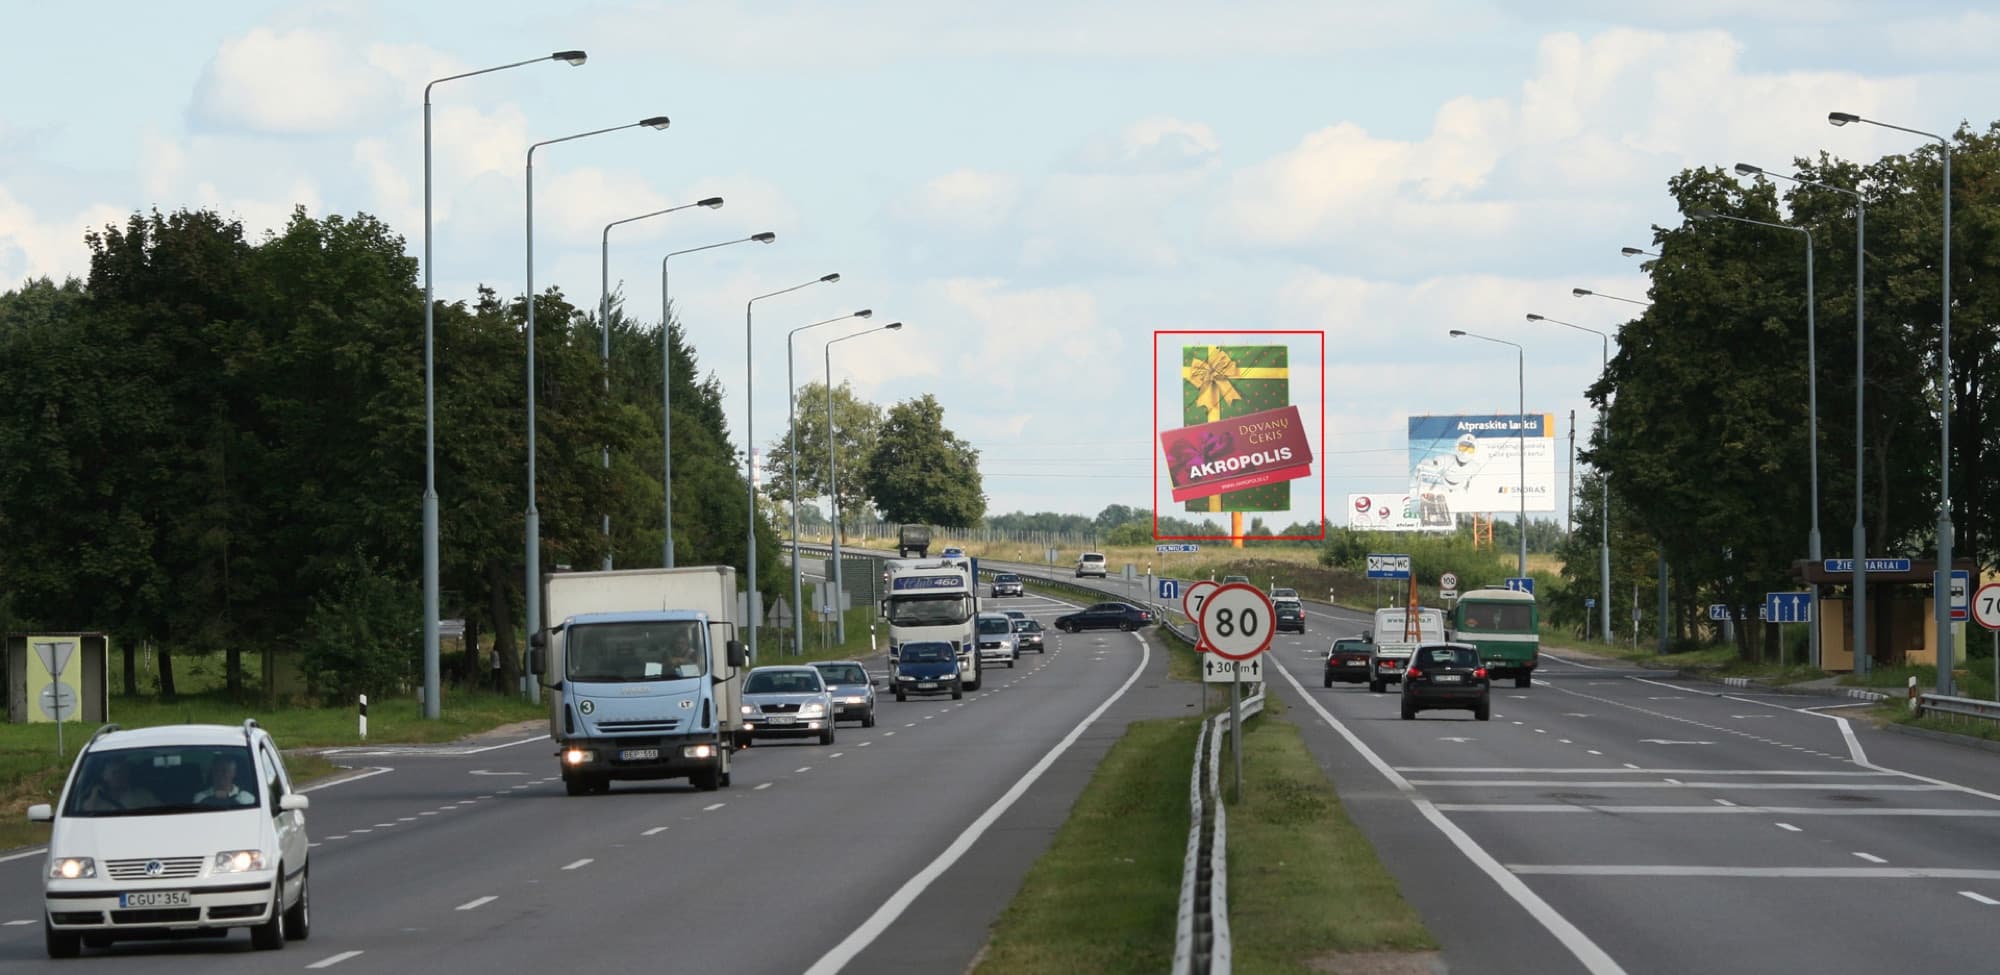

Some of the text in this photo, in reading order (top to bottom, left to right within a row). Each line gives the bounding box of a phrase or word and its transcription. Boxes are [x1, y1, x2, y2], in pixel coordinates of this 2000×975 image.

[1239, 418, 1288, 435] DOVANŲ
[1457, 420, 1507, 432] Atpraskite
[1190, 447, 1292, 478] AKROPOLIS
[1397, 560, 1408, 568] WC
[1443, 577, 1455, 585] 100
[1194, 595, 1204, 611] 7
[1216, 608, 1258, 637] 80
[582, 701, 592, 714] 3
[128, 892, 187, 905] CGU 354
